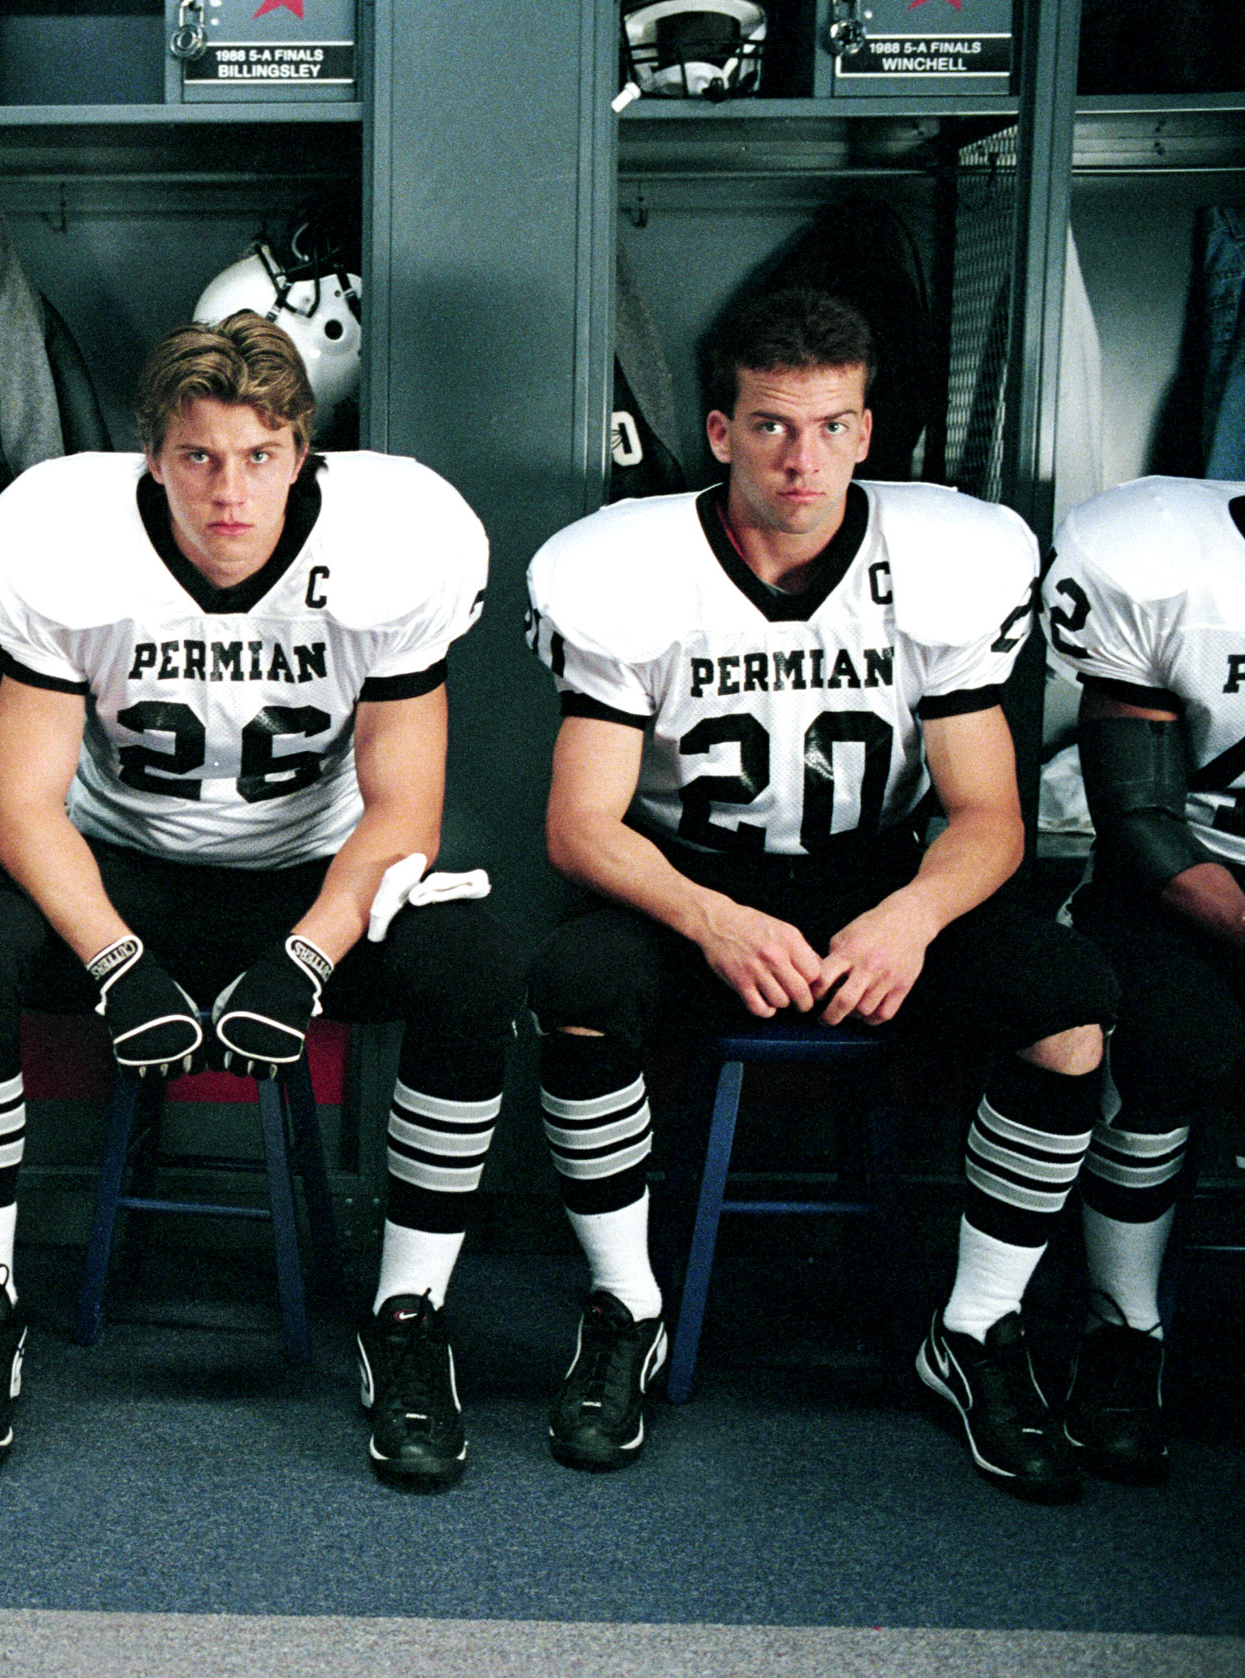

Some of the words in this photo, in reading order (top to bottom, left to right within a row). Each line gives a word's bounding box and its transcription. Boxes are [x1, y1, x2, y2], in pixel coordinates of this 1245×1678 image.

[215, 49, 246, 61] 1988
[249, 49, 272, 61] 5-A
[274, 48, 324, 61] FINALS
[869, 42, 901, 54] 1988
[903, 42, 928, 54] 5-A
[930, 41, 982, 54] FINALS
[882, 57, 968, 71] WINCHELL
[218, 64, 321, 78] BILLINGSLEY
[305, 566, 331, 609] C
[868, 561, 893, 605] C
[128, 640, 328, 684] PERMIAN
[690, 646, 894, 698] PERMIAN
[116, 700, 332, 804] 26
[678, 710, 894, 853] 20
[90, 940, 137, 980] CUTTERS
